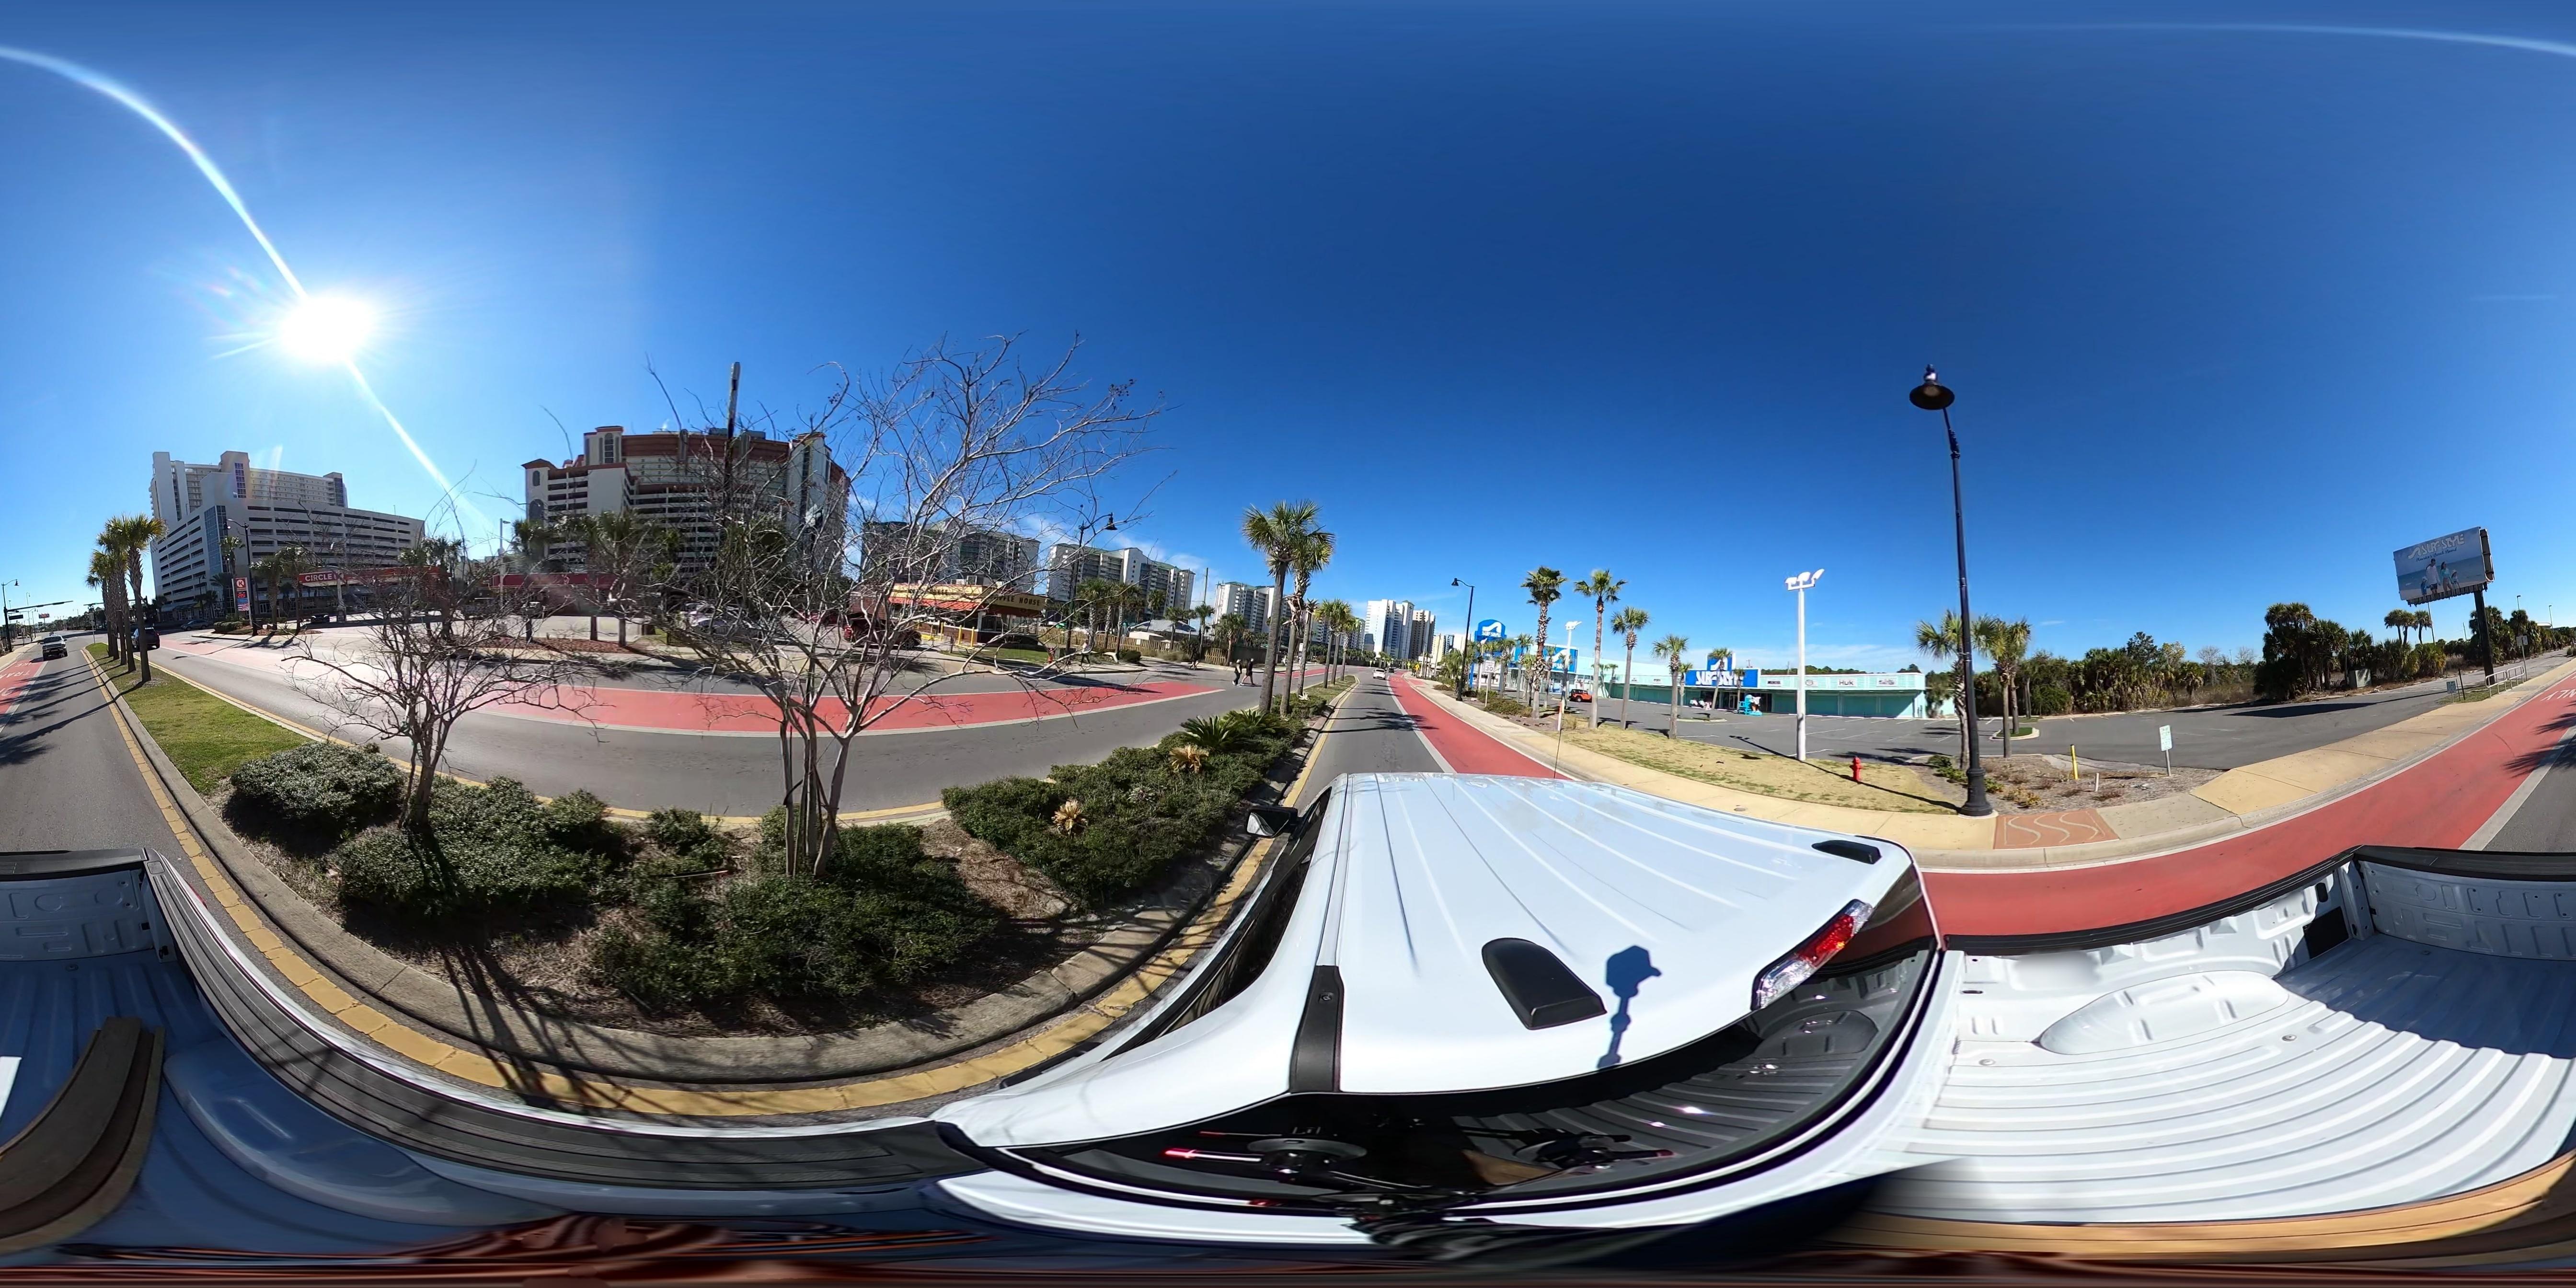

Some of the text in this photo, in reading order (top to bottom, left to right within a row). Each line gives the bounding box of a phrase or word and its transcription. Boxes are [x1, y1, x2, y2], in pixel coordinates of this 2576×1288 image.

[2421, 533, 2465, 554] SURF STYLE
[1019, 597, 1040, 606] HOUSE
